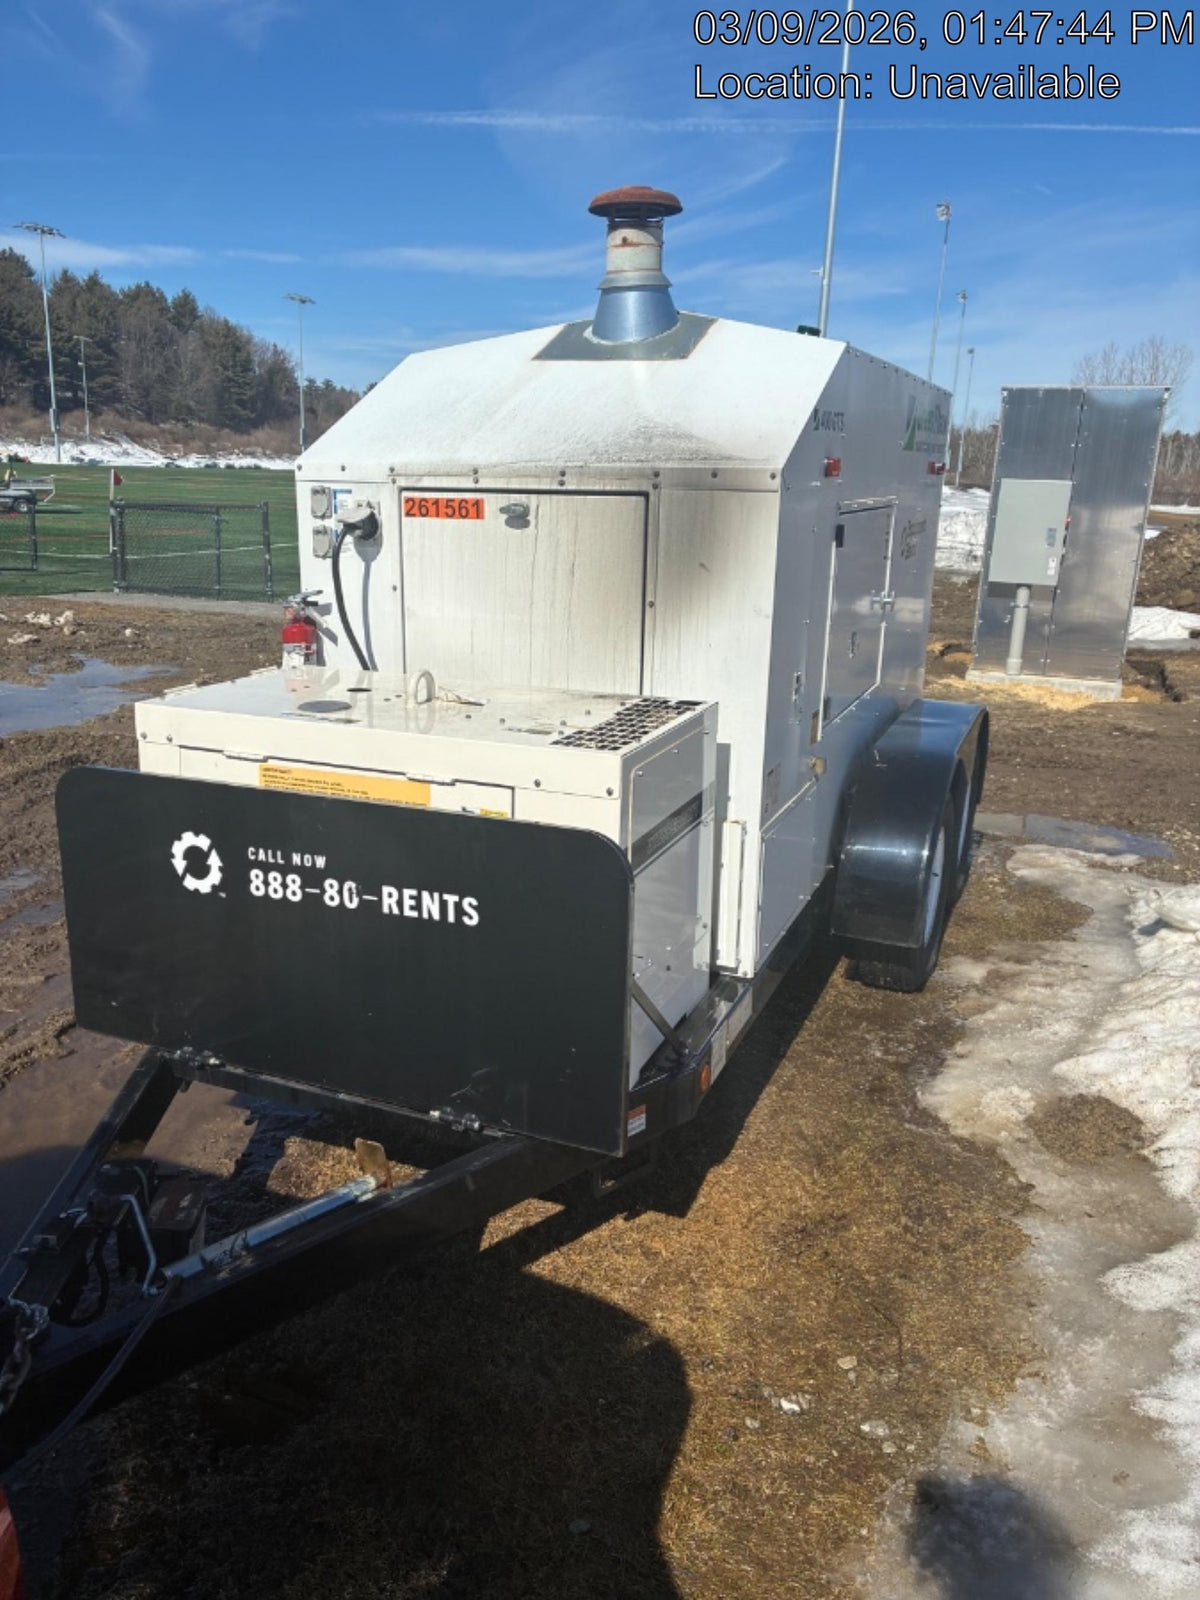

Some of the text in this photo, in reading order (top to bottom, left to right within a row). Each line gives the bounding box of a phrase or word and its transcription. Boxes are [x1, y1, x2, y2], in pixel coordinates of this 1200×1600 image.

[405, 498, 481, 518] 261561
[248, 847, 326, 869] CALL NOW
[249, 869, 480, 926] 888-80-RENTS
